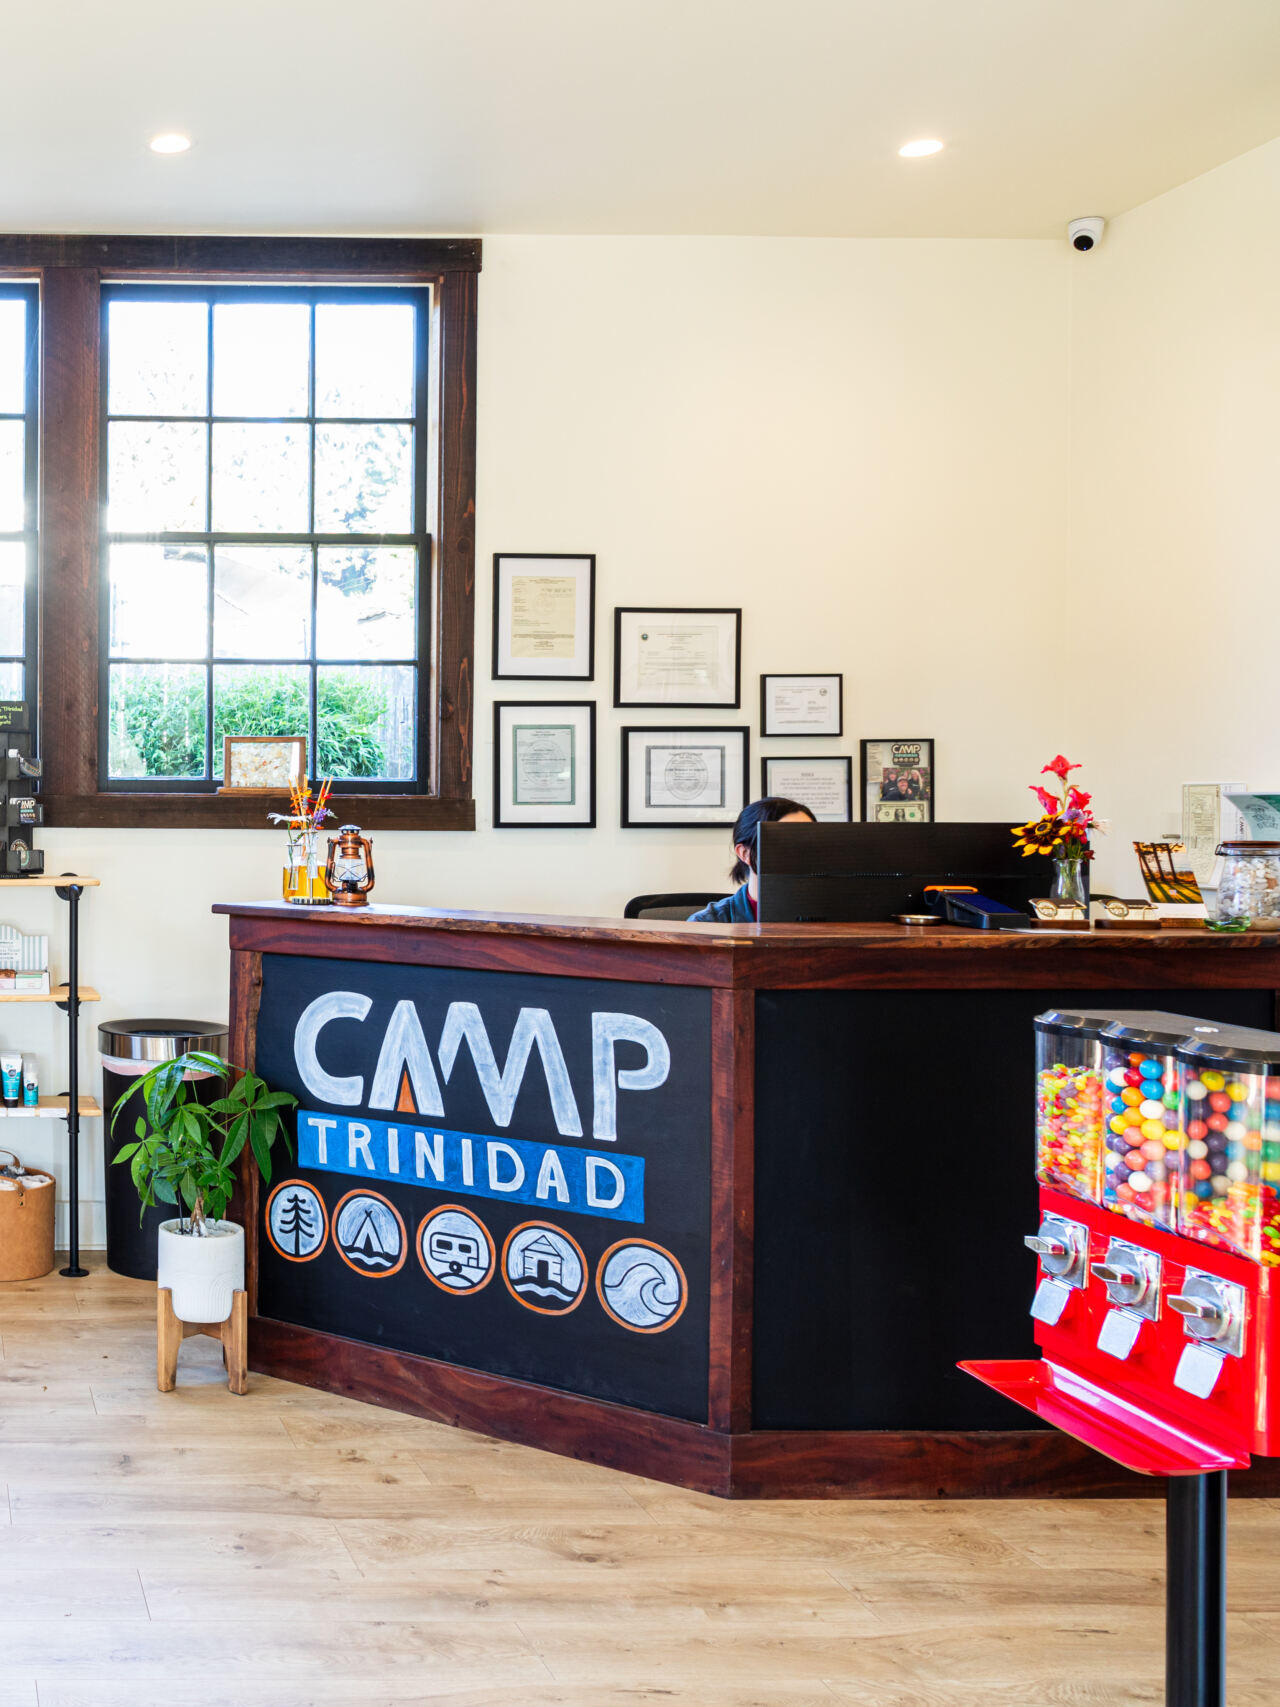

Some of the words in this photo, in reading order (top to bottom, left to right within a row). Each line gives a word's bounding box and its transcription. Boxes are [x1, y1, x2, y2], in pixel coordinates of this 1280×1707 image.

[892, 745, 921, 754] CAMP
[294, 991, 671, 1142] CAMP
[307, 1117, 626, 1209] TRINIDAD
